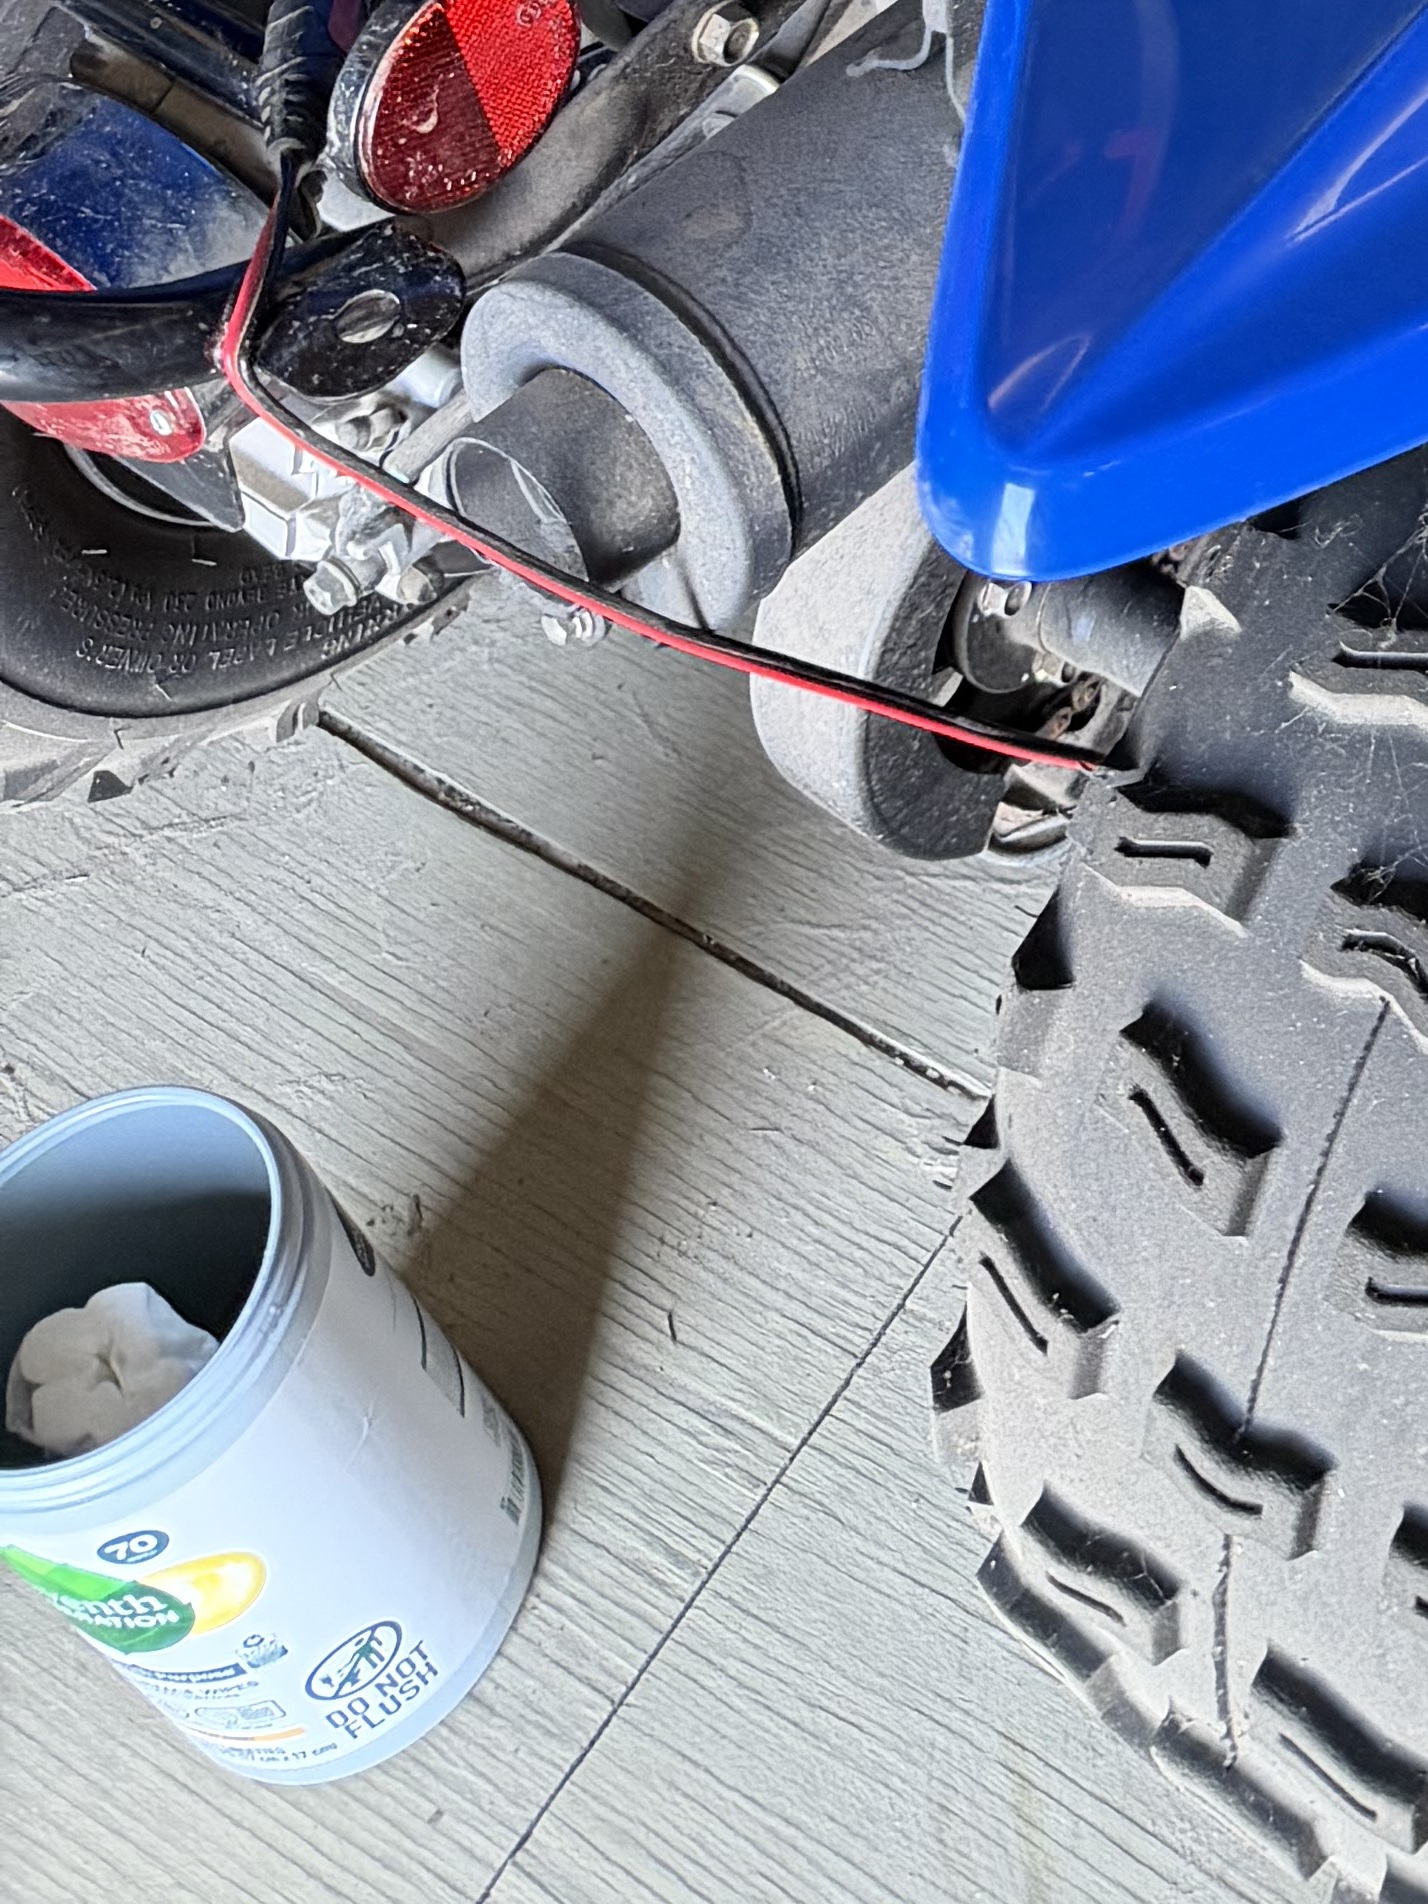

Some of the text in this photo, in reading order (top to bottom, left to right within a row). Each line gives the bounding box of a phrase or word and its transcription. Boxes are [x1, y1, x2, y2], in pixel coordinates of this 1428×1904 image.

[104, 1534, 158, 1561] 70
[325, 1639, 428, 1729] DO NOT
[344, 1661, 439, 1740] FLUSH
